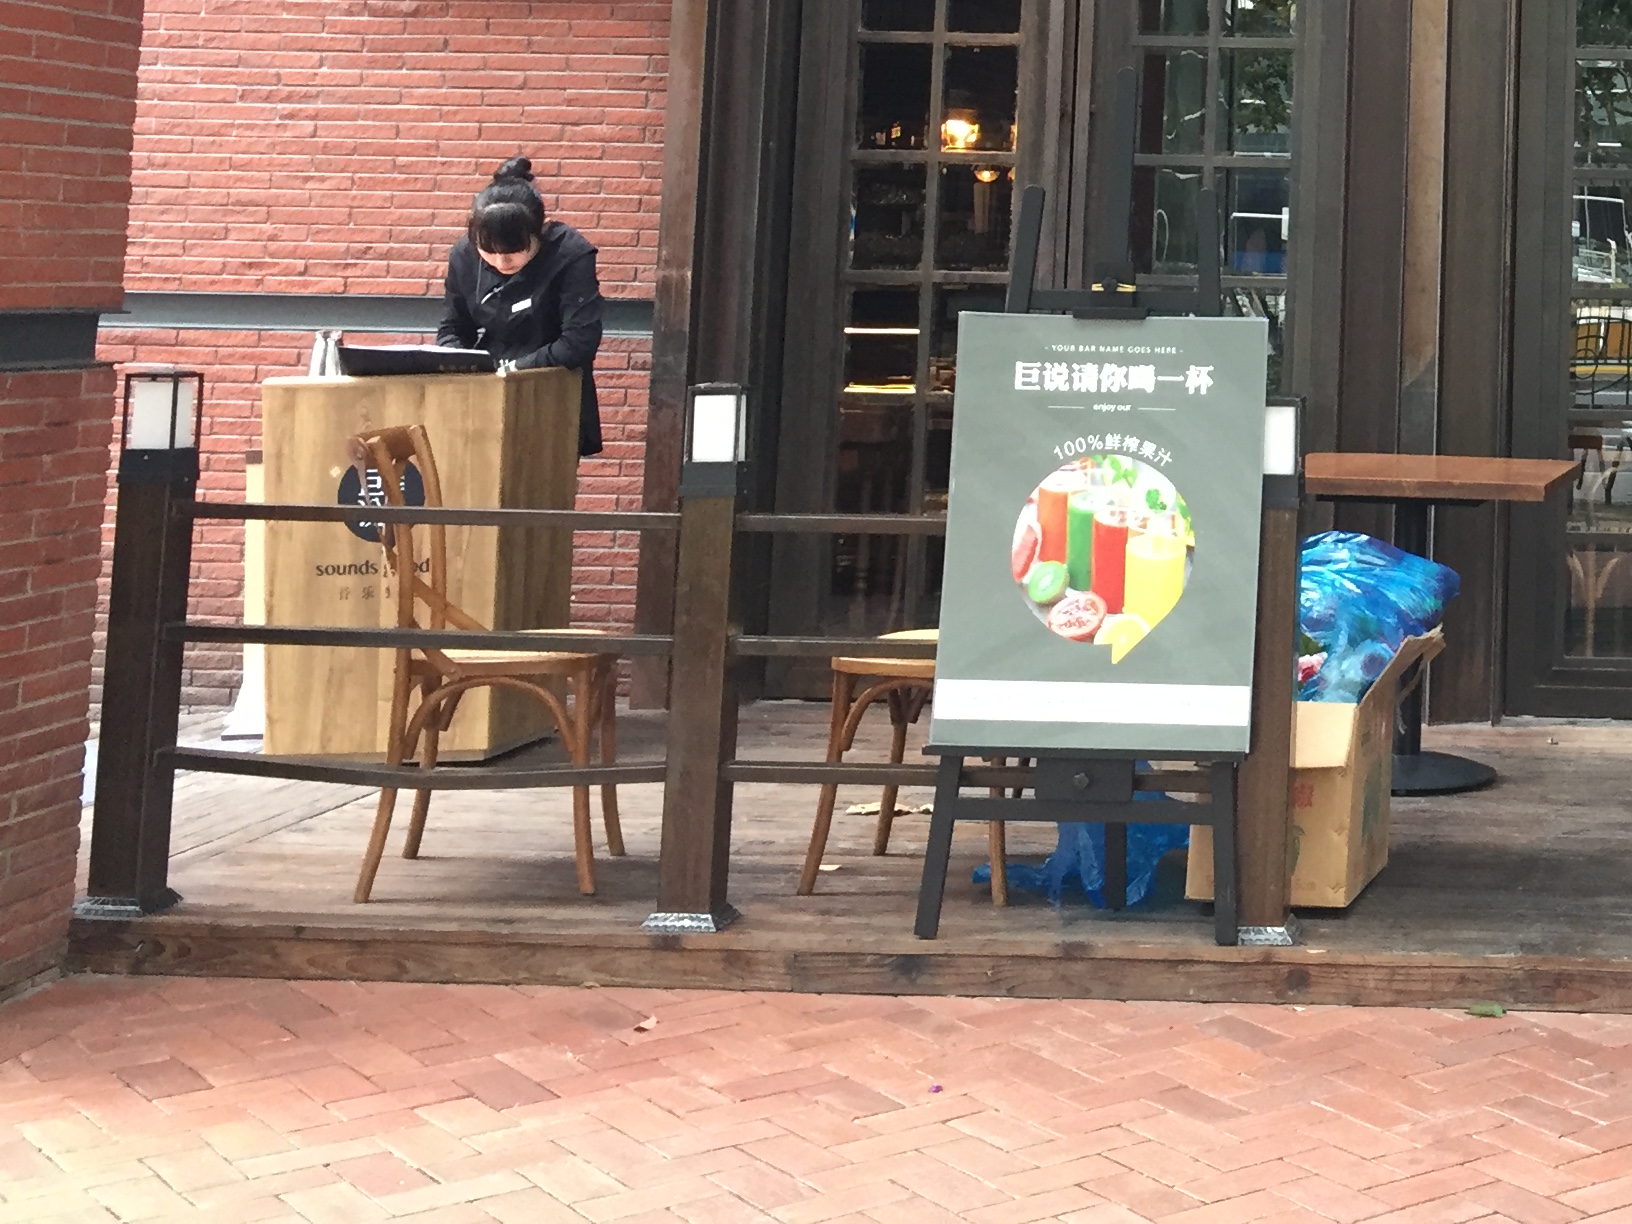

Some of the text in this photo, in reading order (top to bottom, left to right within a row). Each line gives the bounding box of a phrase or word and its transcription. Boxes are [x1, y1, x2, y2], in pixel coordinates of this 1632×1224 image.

[1051, 344, 1076, 352] YOUR
[1099, 345, 1124, 353] NAME
[1127, 346, 1151, 354] GOES
[1154, 347, 1177, 355] HERE
[1093, 403, 1132, 413] enjoy our
[315, 559, 379, 577] sounds
